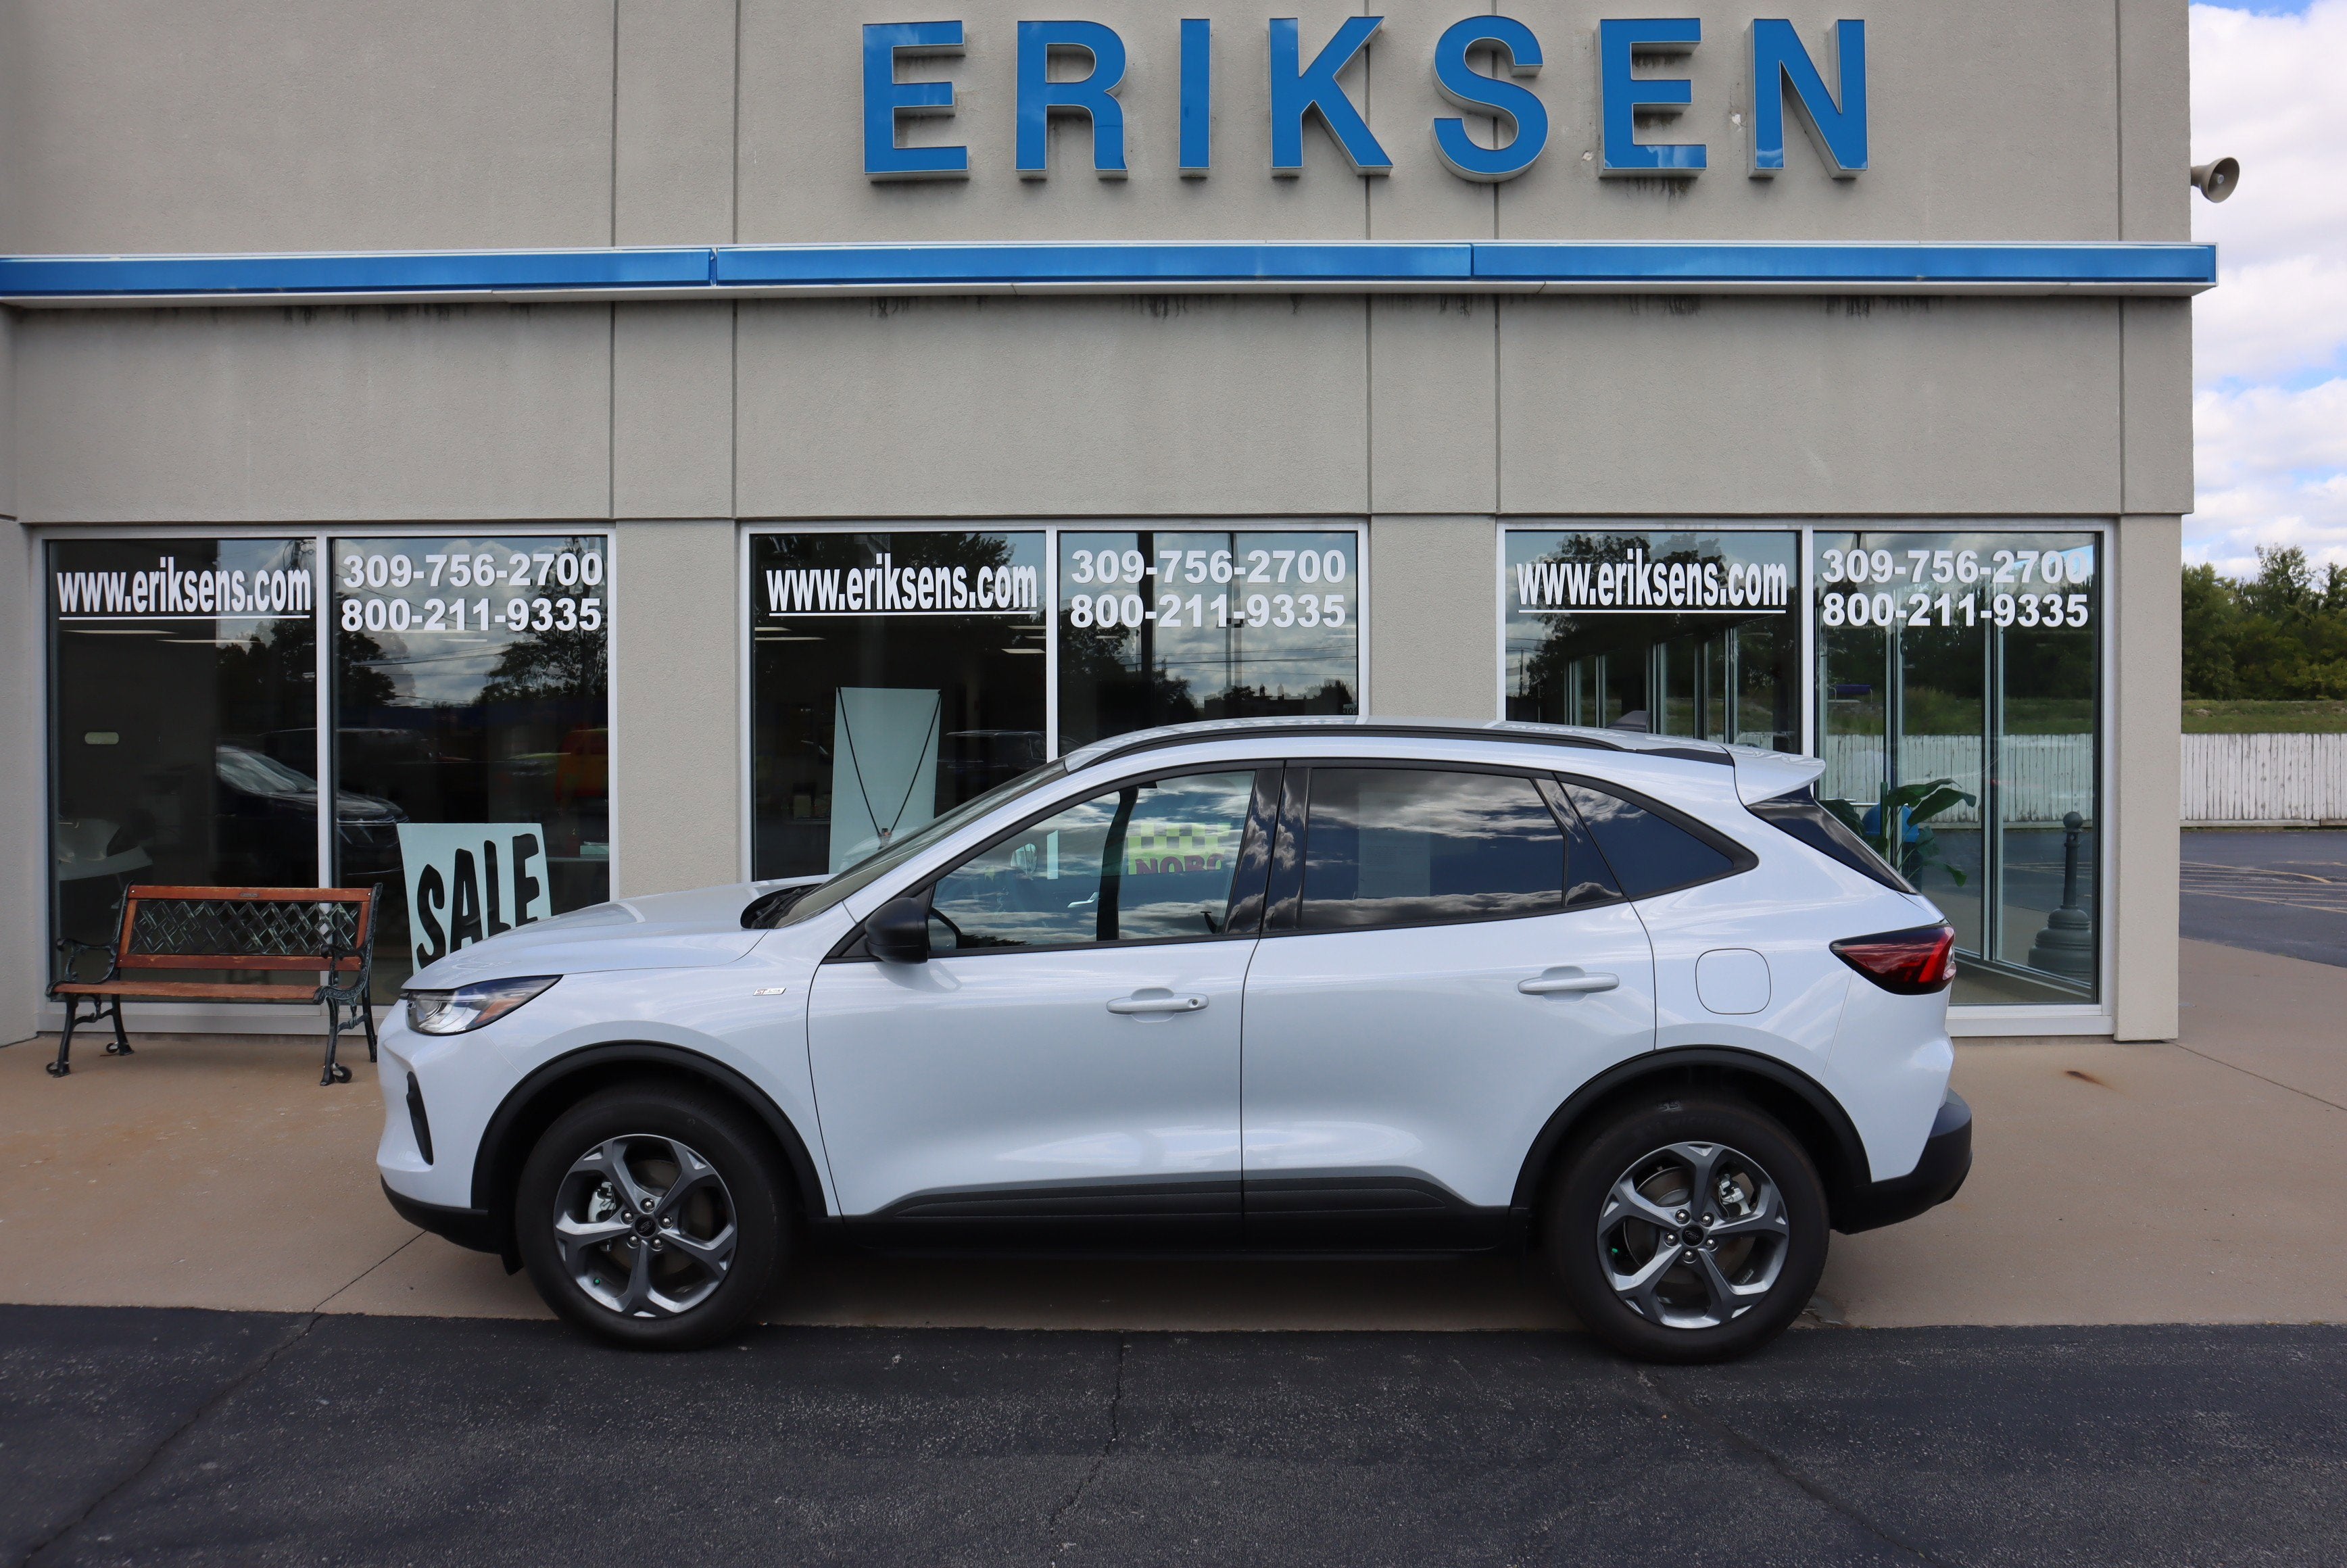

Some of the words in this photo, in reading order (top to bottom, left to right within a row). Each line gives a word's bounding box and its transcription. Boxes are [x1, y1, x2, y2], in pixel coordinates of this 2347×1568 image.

[862, 15, 1868, 183] ERIKSEN
[57, 556, 311, 612] www.eriksens.com
[343, 553, 603, 588] 309-756-2700
[767, 553, 1037, 611] www.eriksens.com
[1072, 549, 1347, 585] 309-756-2700
[1516, 548, 1787, 606] www.eriksens.com
[1822, 549, 2087, 584] 309-756-2700
[341, 597, 602, 632] 800-211-9335
[1071, 593, 1345, 629] 800-211-9335
[1822, 593, 2089, 627] 800-211-9335
[416, 833, 540, 969] SALE
